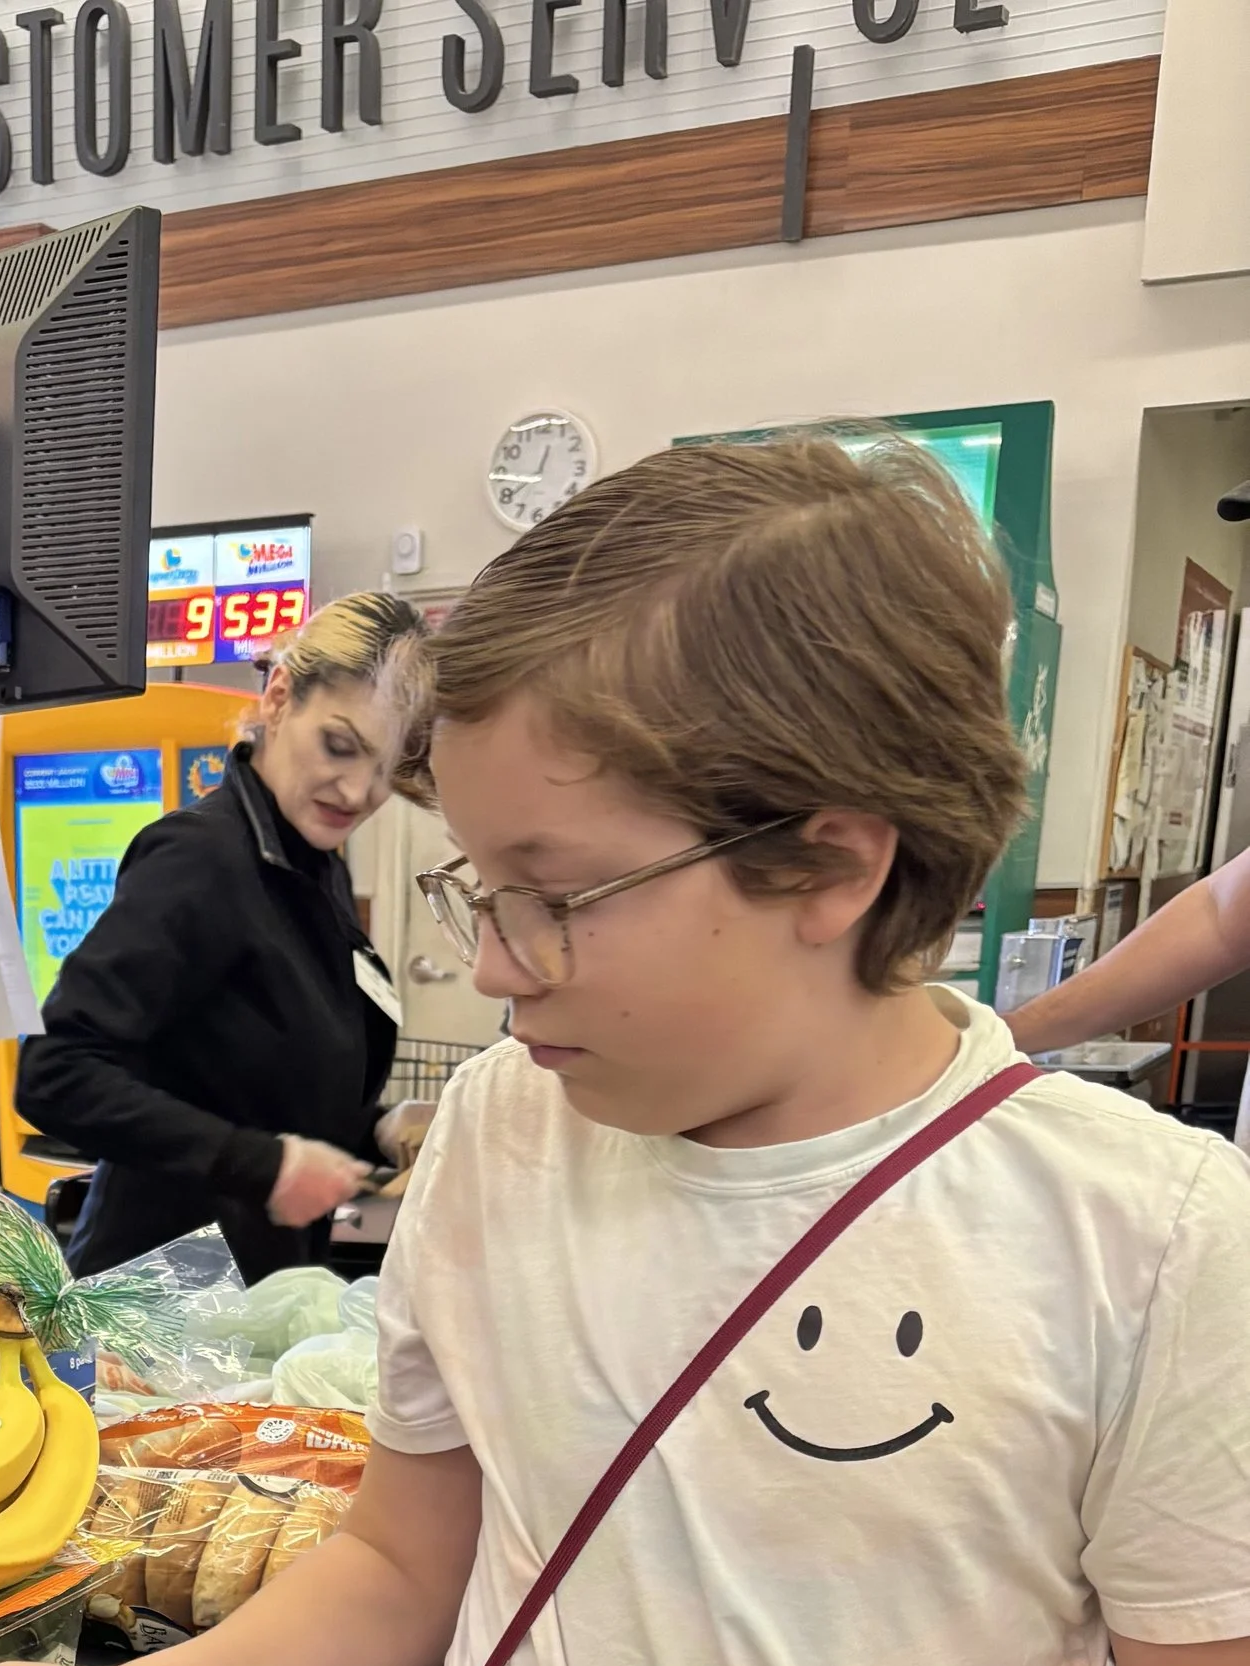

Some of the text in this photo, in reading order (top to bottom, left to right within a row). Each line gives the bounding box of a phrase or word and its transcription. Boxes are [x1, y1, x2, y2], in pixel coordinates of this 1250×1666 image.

[568, 436, 583, 453] 2
[499, 487, 514, 504] 8
[514, 502, 527, 519] 7
[185, 596, 214, 641] 9
